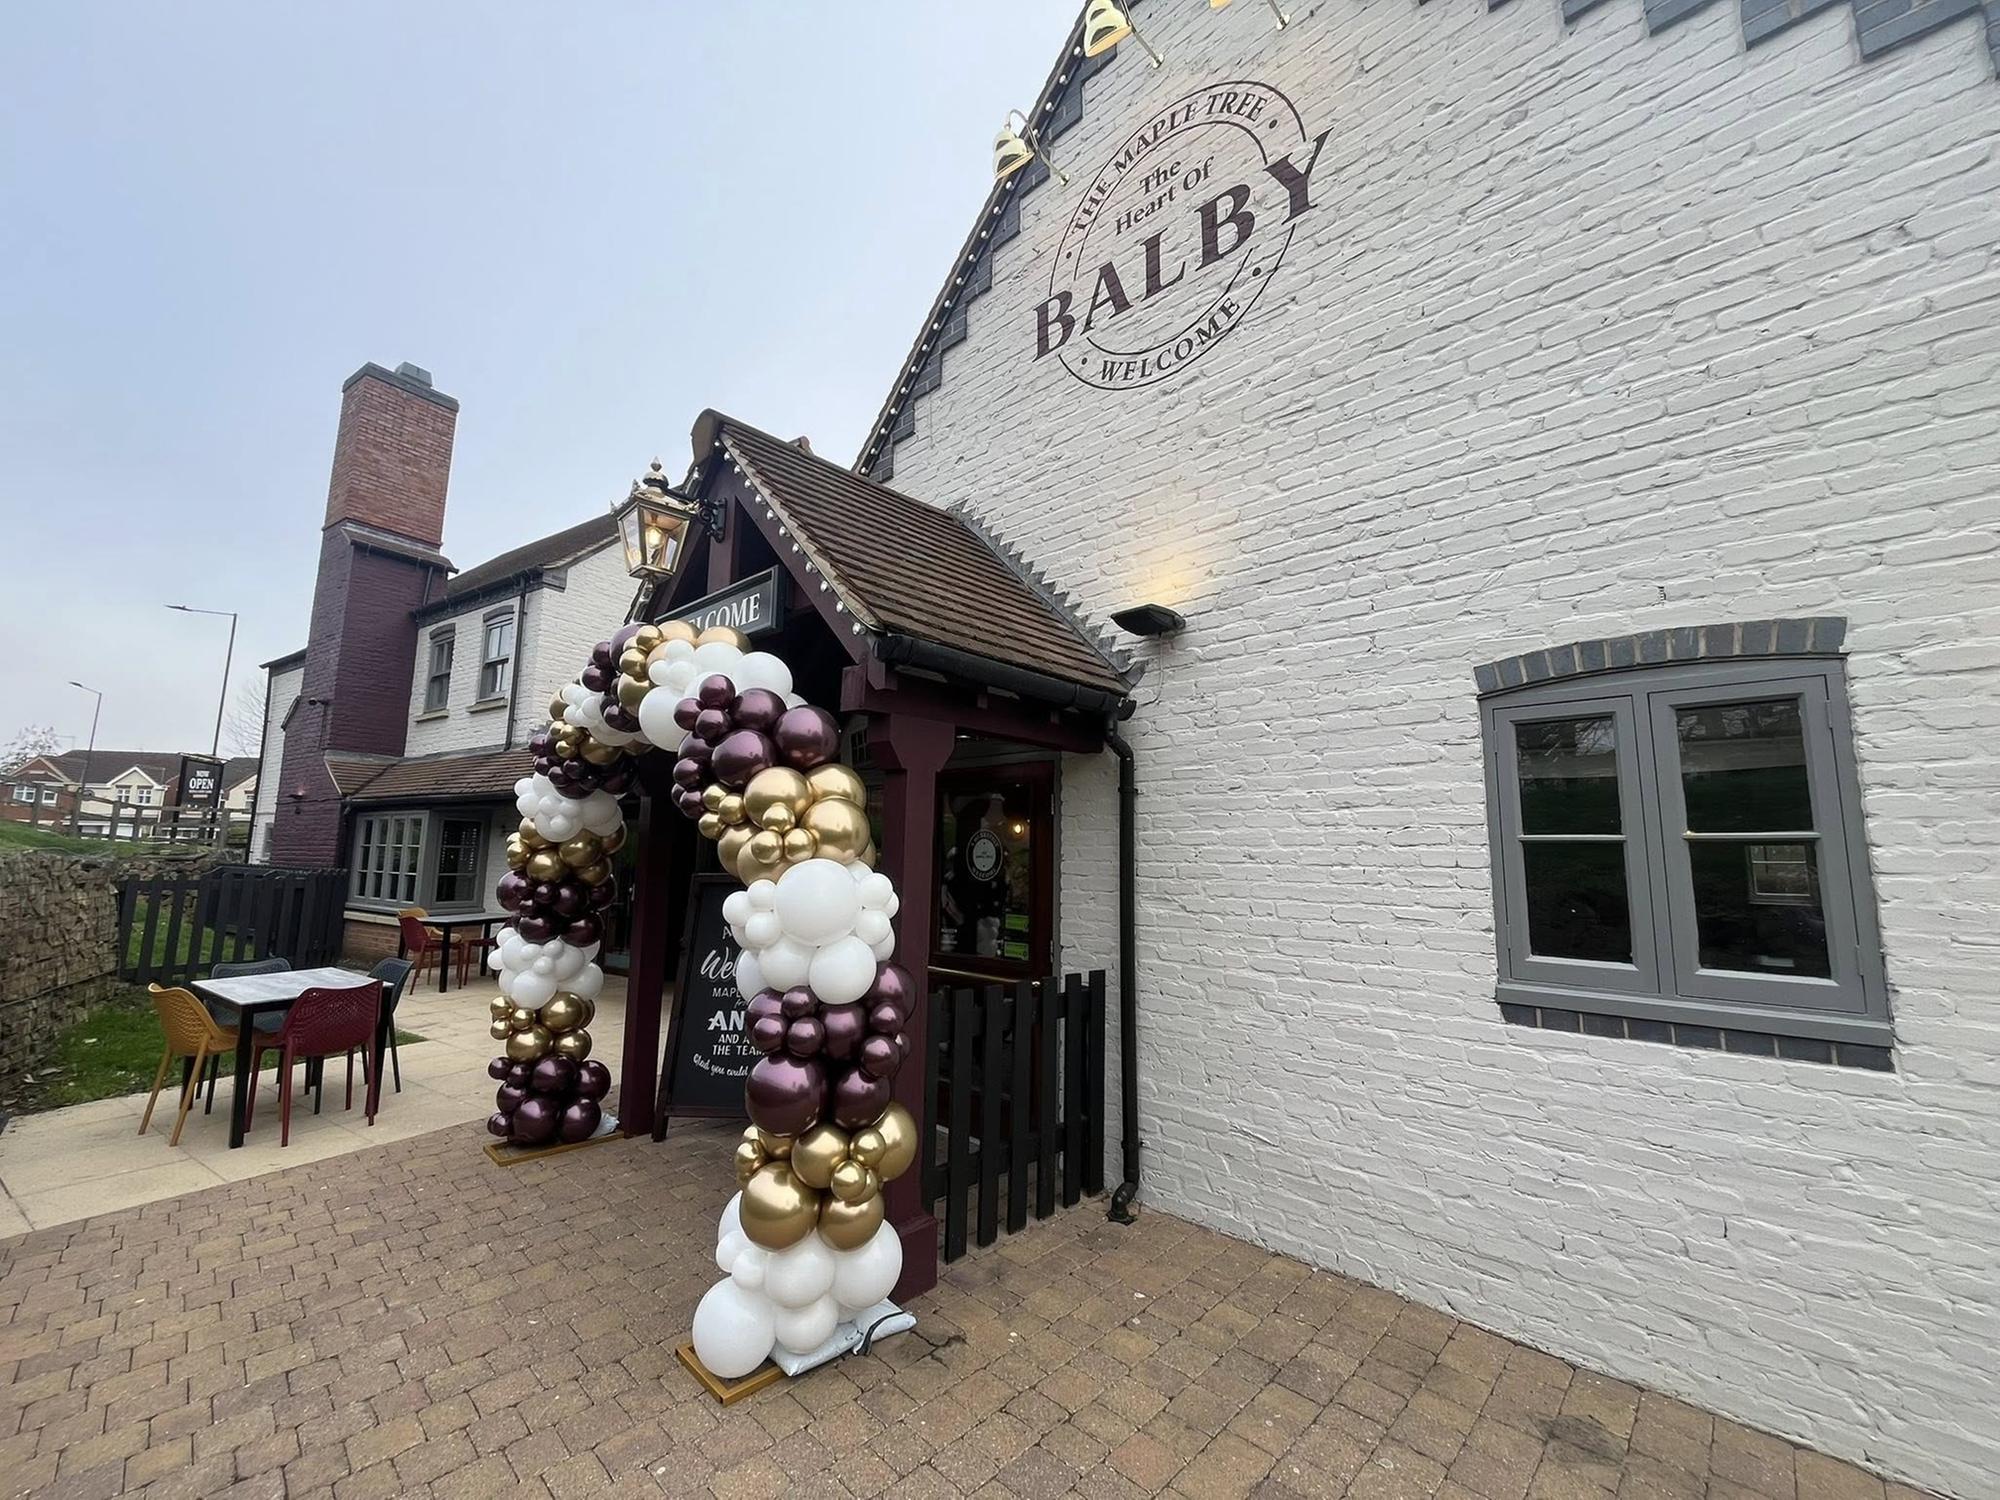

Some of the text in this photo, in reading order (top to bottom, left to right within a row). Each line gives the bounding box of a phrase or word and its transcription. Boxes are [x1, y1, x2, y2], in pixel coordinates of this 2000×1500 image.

[1072, 91, 1268, 235] THE MAPLE TREE
[1139, 158, 1181, 195] The
[1115, 155, 1215, 235] Heart Of
[1032, 127, 1334, 362] BALBY
[1100, 297, 1241, 382] WELCOME
[189, 778, 214, 789] OPEN
[712, 987, 741, 998] MAPL
[707, 1010, 746, 1031] AN
[712, 1044, 731, 1056] THE
[718, 1034, 740, 1044] AND
[693, 1053, 748, 1077] Glad you could
